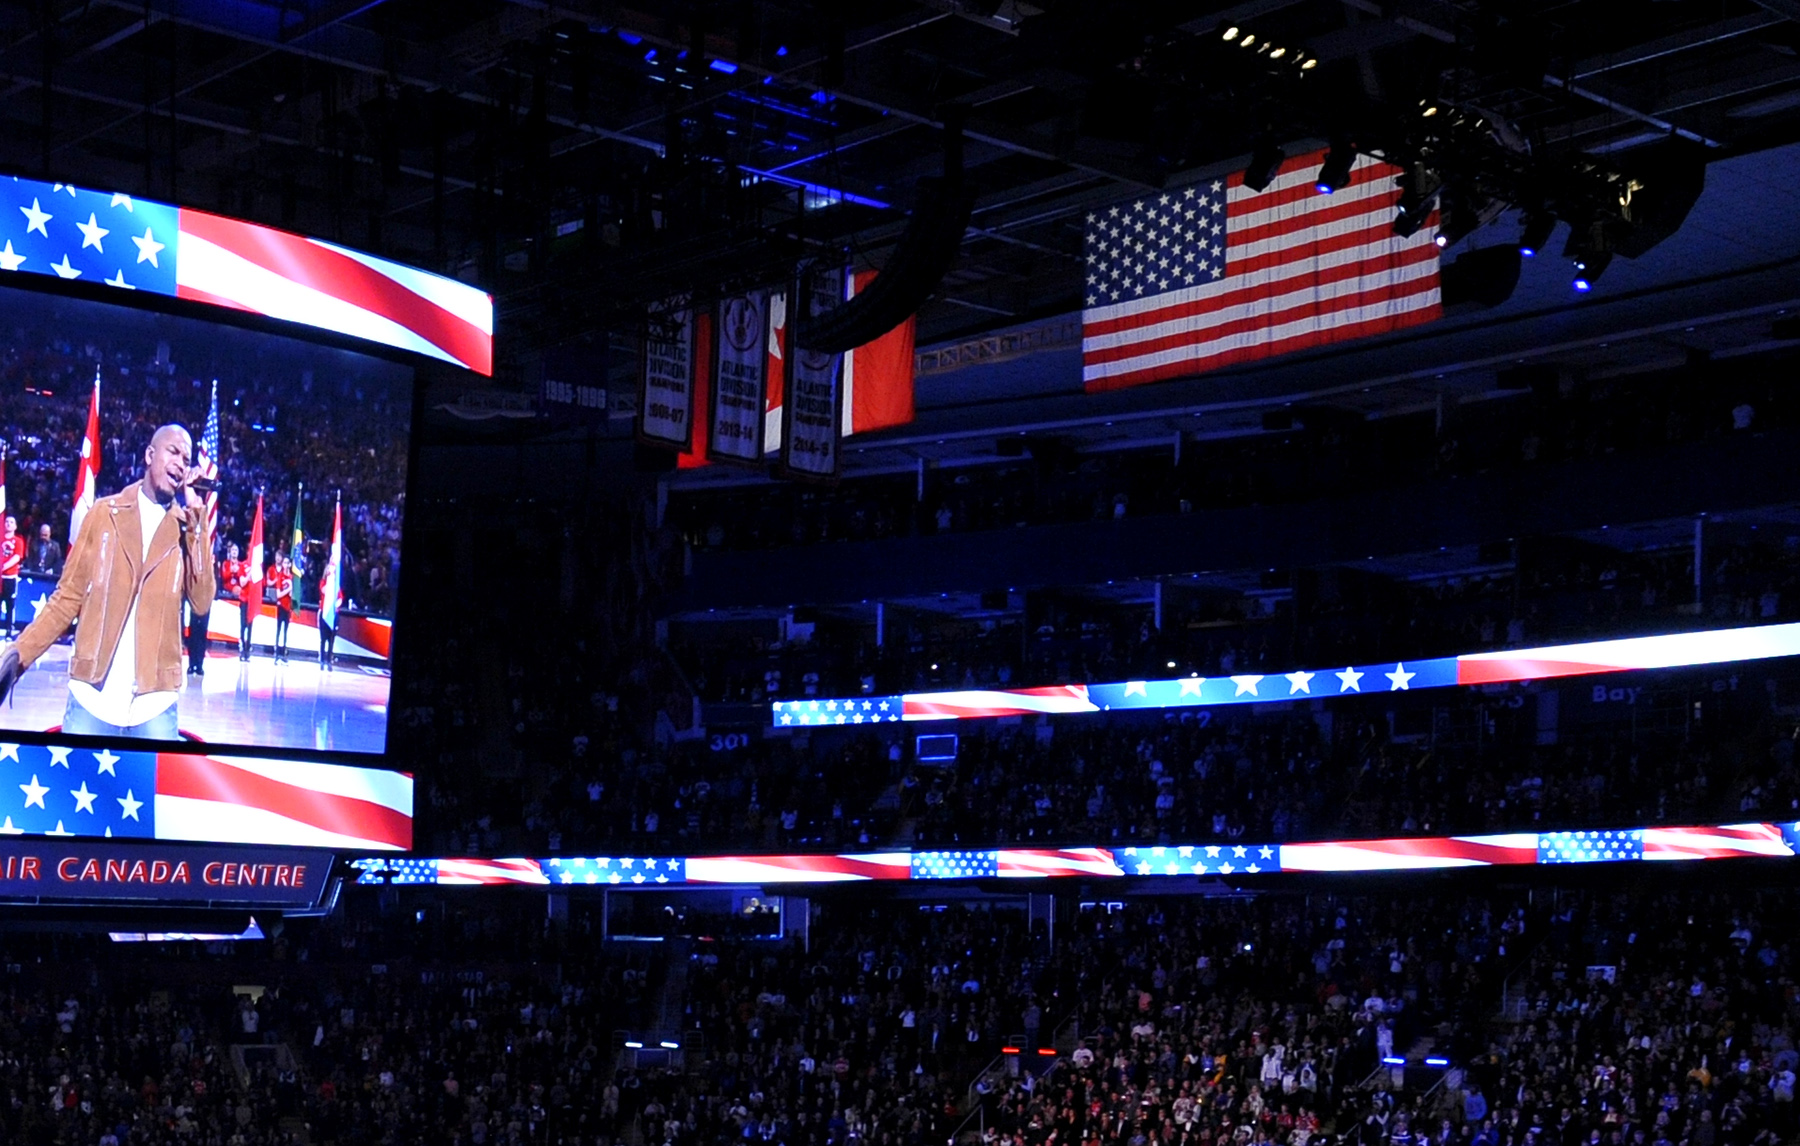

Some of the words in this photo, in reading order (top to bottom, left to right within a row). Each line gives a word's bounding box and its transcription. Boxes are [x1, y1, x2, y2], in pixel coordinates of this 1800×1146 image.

[709, 732, 749, 751] 301
[56, 857, 192, 885] CANADA
[202, 861, 307, 888] CENTRE
